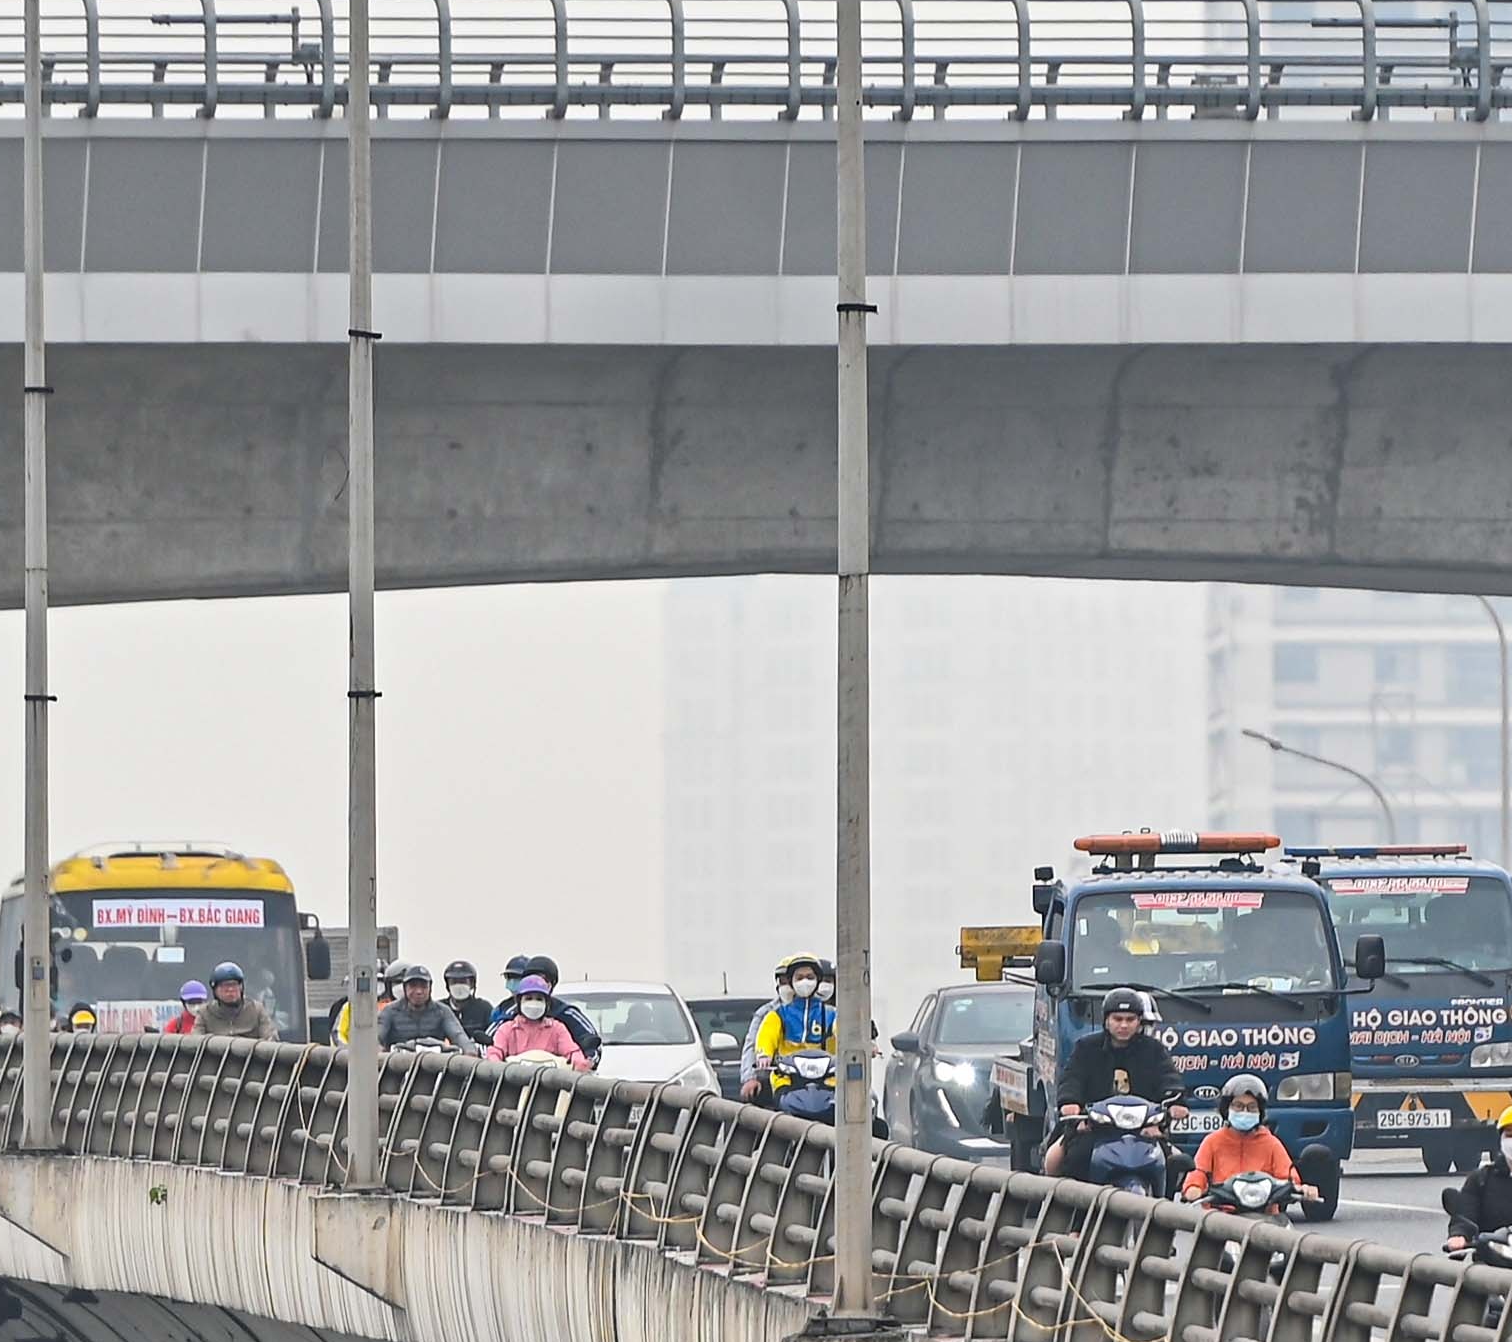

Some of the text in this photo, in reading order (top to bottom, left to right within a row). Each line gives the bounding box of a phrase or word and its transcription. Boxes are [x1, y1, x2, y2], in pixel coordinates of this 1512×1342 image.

[225, 908, 260, 924] GIANG
[1353, 1007, 1508, 1030] HỘ GIAO THÔNG
[1183, 1029, 1238, 1047] GIAO
[1241, 1025, 1317, 1046] THÔNG
[1379, 1112, 1449, 1127] 29C-975.11
